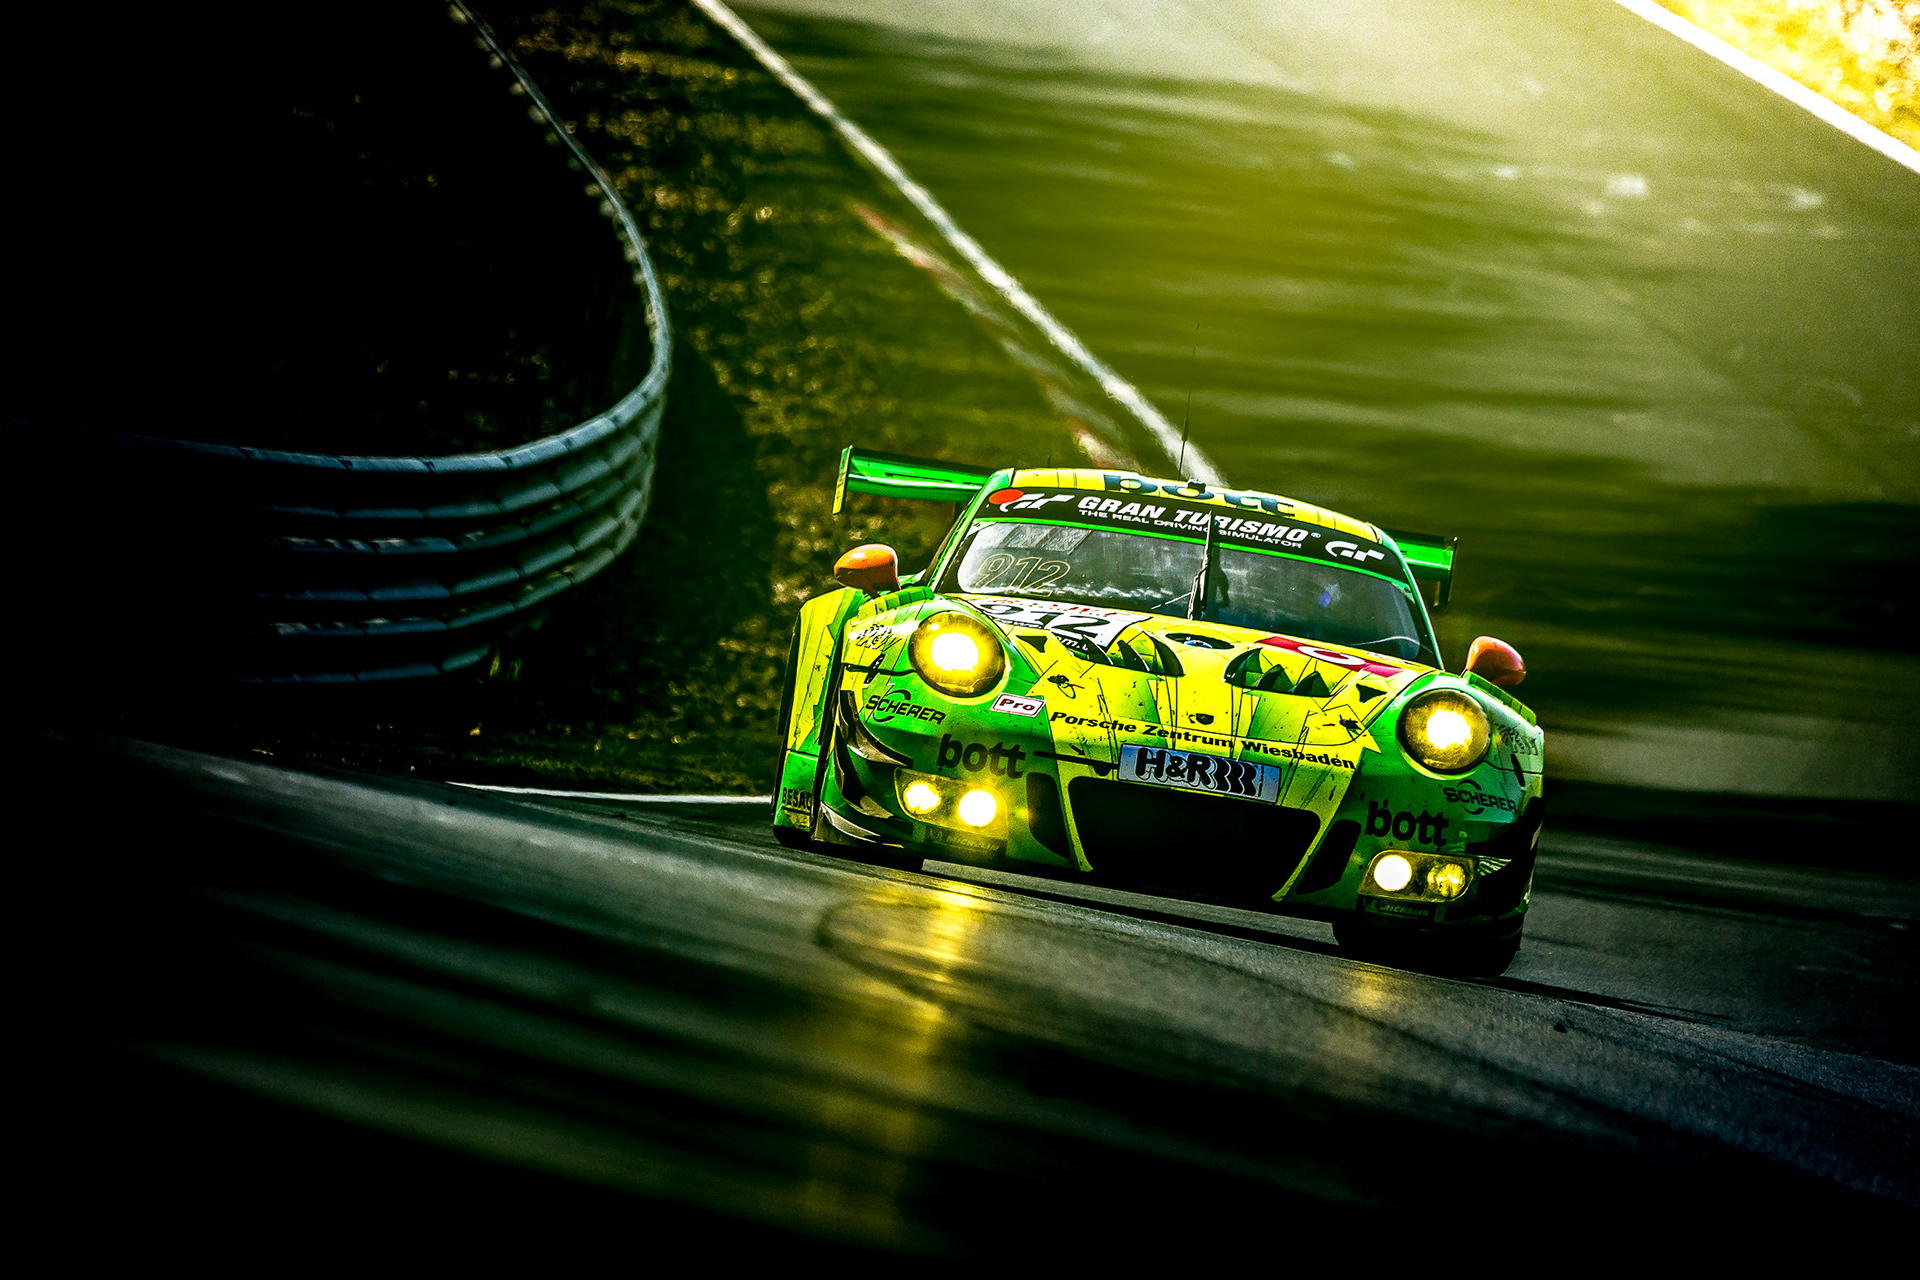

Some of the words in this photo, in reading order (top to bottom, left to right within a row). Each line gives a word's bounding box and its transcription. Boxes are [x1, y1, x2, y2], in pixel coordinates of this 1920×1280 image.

[1077, 496, 1166, 519] GRAN
[1079, 509, 1108, 519] THE
[1112, 513, 1150, 524] REAL
[1218, 530, 1302, 549] SIMULATOR
[970, 552, 1071, 598] 912
[866, 694, 946, 725] SCHERER
[999, 698, 1036, 711] Pro
[937, 733, 1027, 779] bott
[1050, 711, 1137, 733] Porsche
[1142, 724, 1233, 748] Zentrum
[1241, 739, 1356, 769] Wiesbaden
[1443, 787, 1517, 813] SCHERER
[1365, 800, 1449, 847] bott
